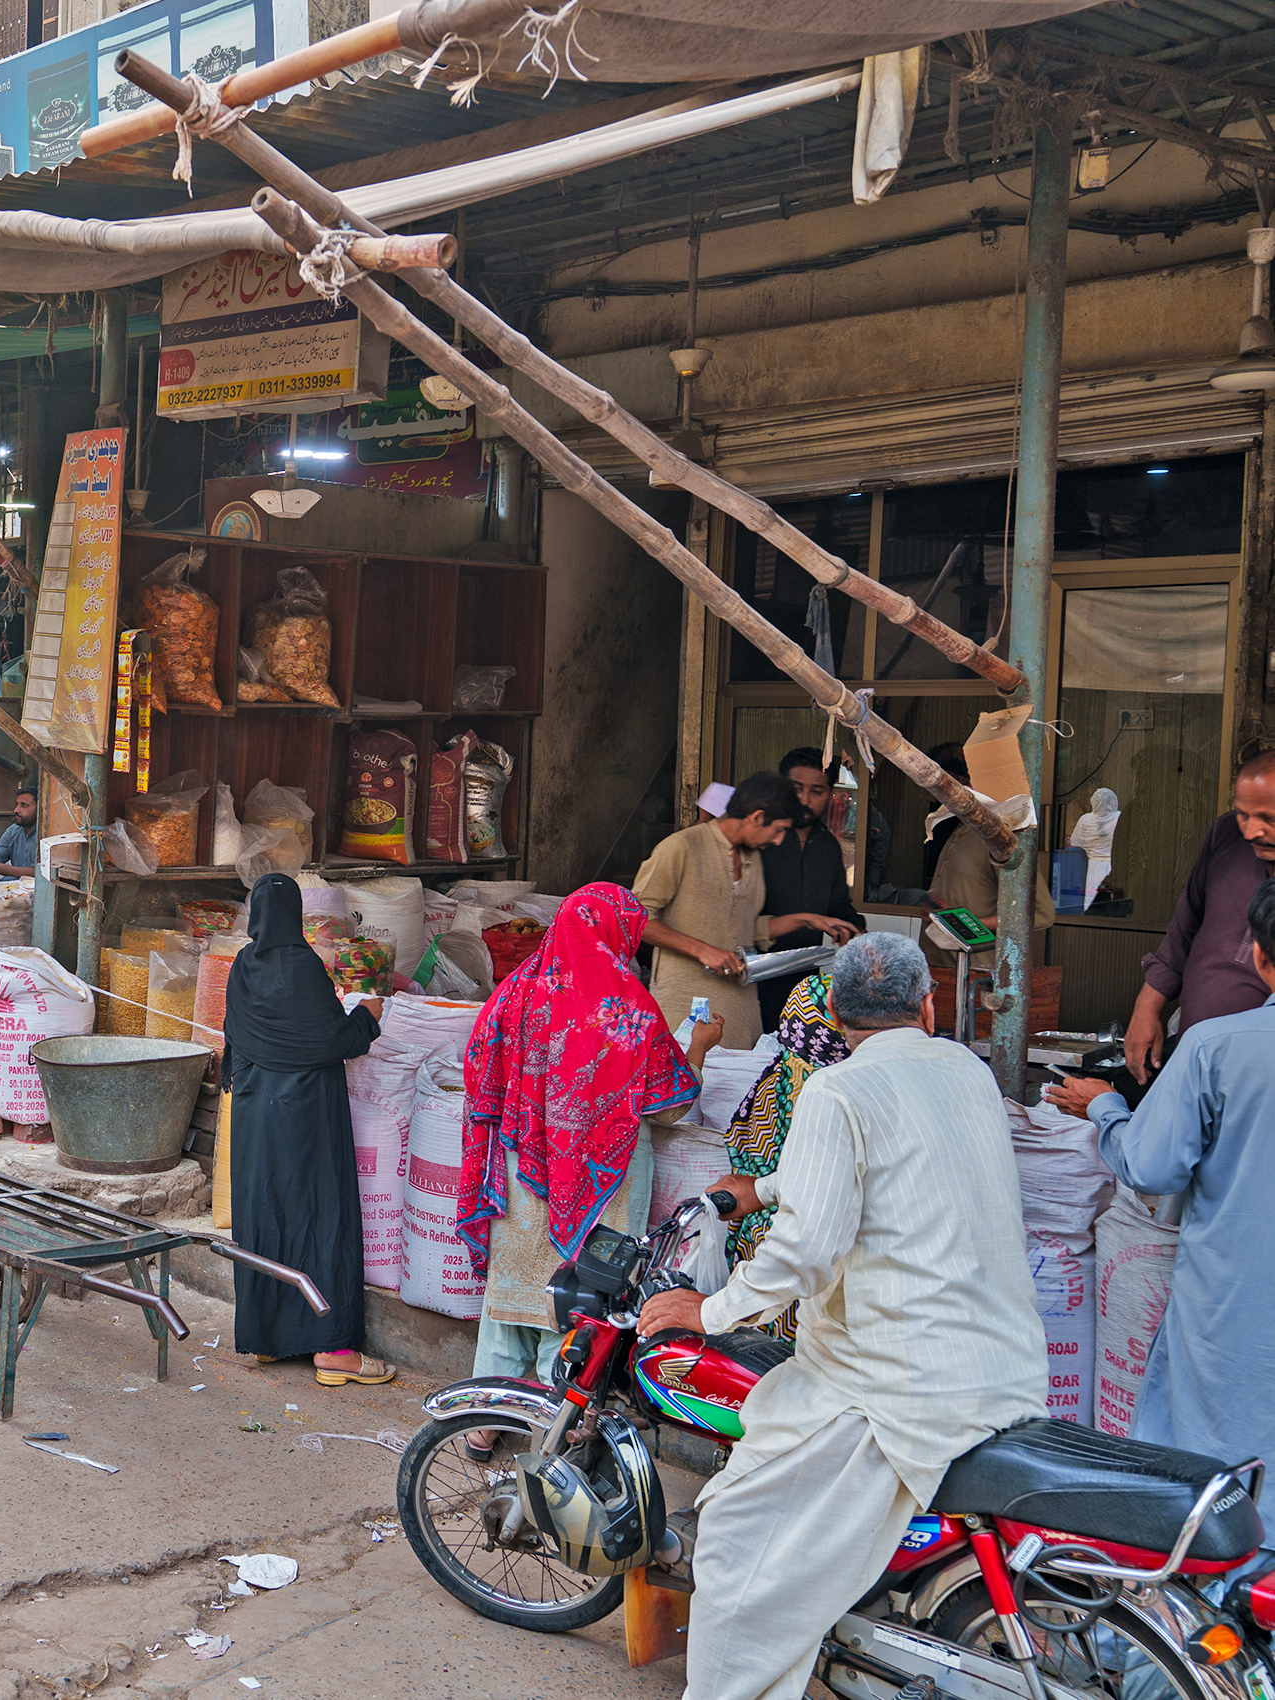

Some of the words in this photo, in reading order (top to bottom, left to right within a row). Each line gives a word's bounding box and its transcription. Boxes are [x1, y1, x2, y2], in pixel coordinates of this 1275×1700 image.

[165, 367, 191, 382] H-1409
[168, 384, 244, 406] 0322-2227937
[259, 372, 342, 395] 0311-3339994
[336, 400, 468, 449] سفینہ
[87, 438, 120, 466] چوہدری
[65, 472, 90, 499] سنز
[90, 463, 113, 498] اینڈ
[106, 504, 118, 520] VIP
[100, 527, 115, 544] VIP
[33, 992, 48, 1015] LTD.
[26, 1033, 46, 1042] ROAD
[8, 1066, 40, 1075] PAKISTA
[9, 1079, 33, 1089] 50.105
[13, 1090, 23, 1100] 50
[6, 1101, 46, 1112] 2025-2026
[408, 1172, 460, 1195] ALLIANCE
[363, 1193, 392, 1203] GHOTKI
[378, 1208, 404, 1221] Sugar
[415, 1207, 445, 1225] DISTRICT
[410, 1222, 428, 1240] White
[429, 1231, 463, 1246] Refined
[363, 1256, 391, 1267] ecember
[443, 1254, 462, 1265] 2025
[442, 1269, 469, 1281] 50.000
[441, 1284, 474, 1296] December
[1066, 1275, 1084, 1311] LTD.
[1048, 1341, 1079, 1355] ROAD
[1104, 1348, 1129, 1372] CHAK
[657, 1374, 700, 1395] HONDA
[1100, 1375, 1136, 1408] WHITE
[705, 1393, 729, 1405] Cash
[1099, 1413, 1129, 1439] GROS
[1211, 1487, 1247, 1515] HONDA
